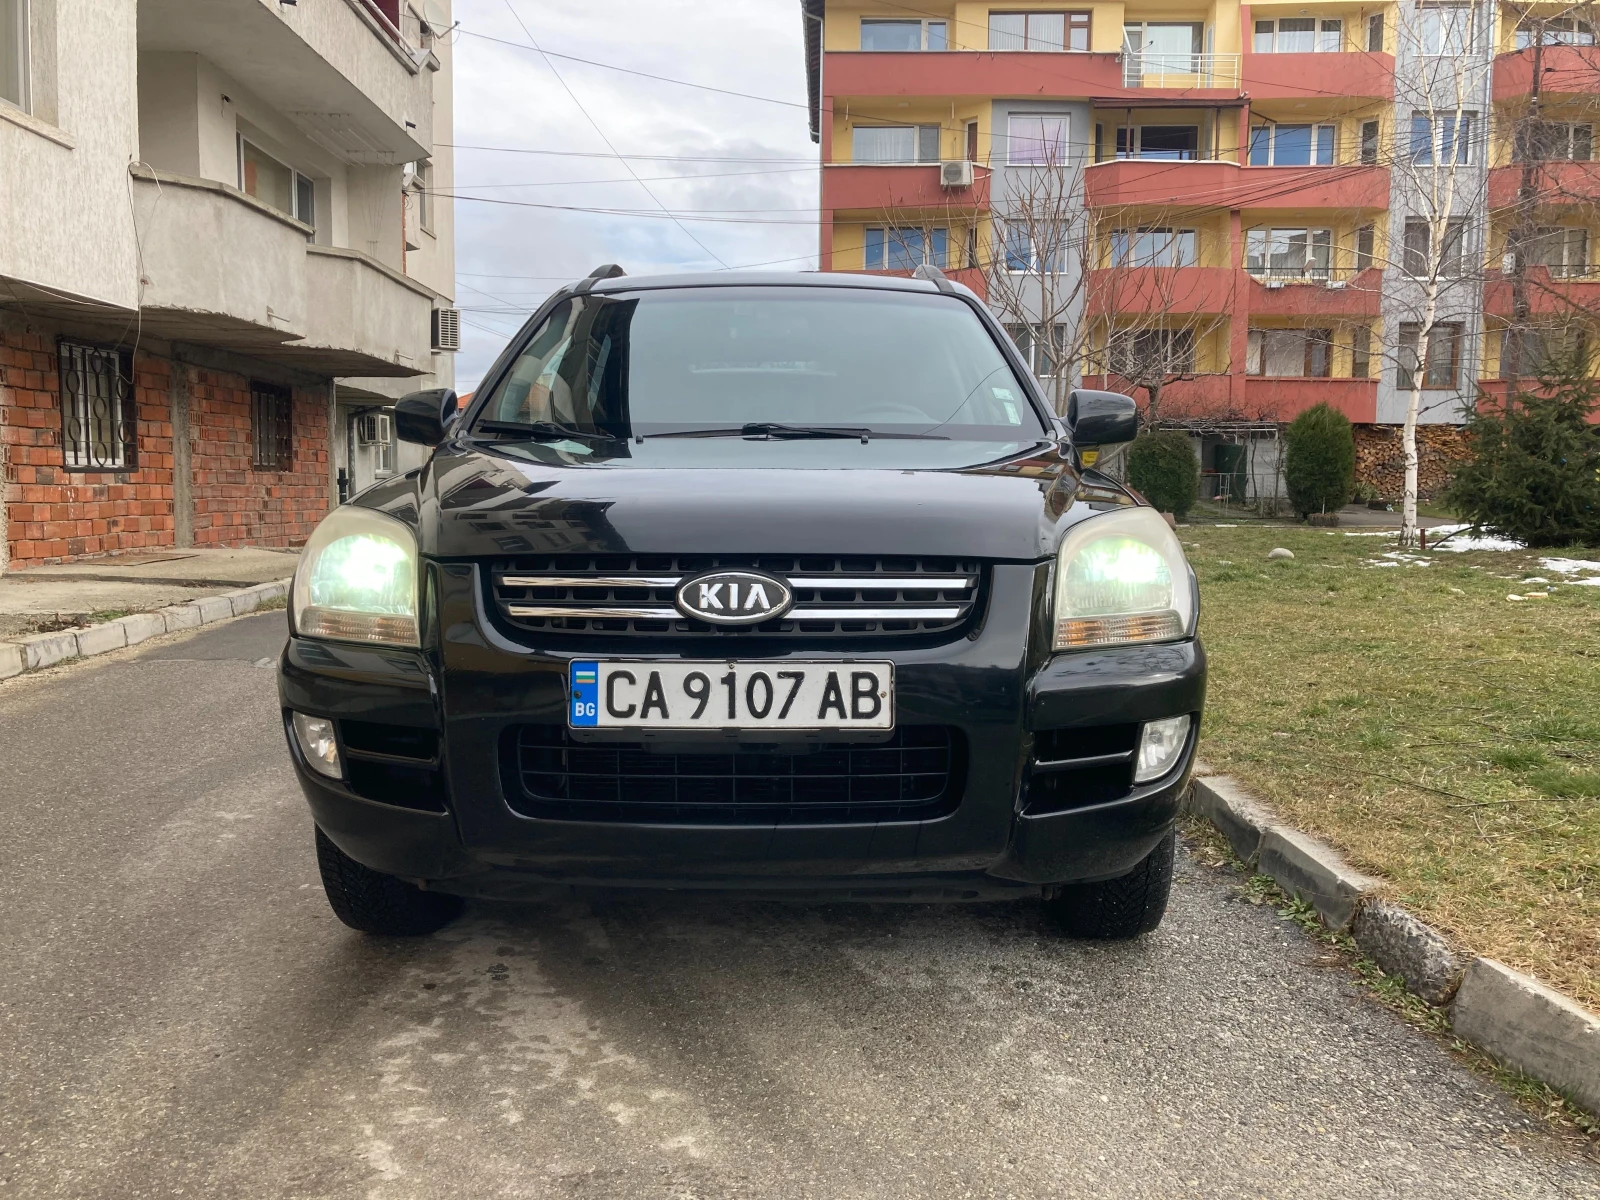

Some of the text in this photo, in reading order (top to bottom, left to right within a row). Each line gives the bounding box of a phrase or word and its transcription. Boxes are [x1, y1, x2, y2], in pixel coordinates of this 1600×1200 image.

[699, 583, 771, 610] KIA
[606, 670, 882, 720] CA 9107 AB
[575, 702, 596, 717] BG
